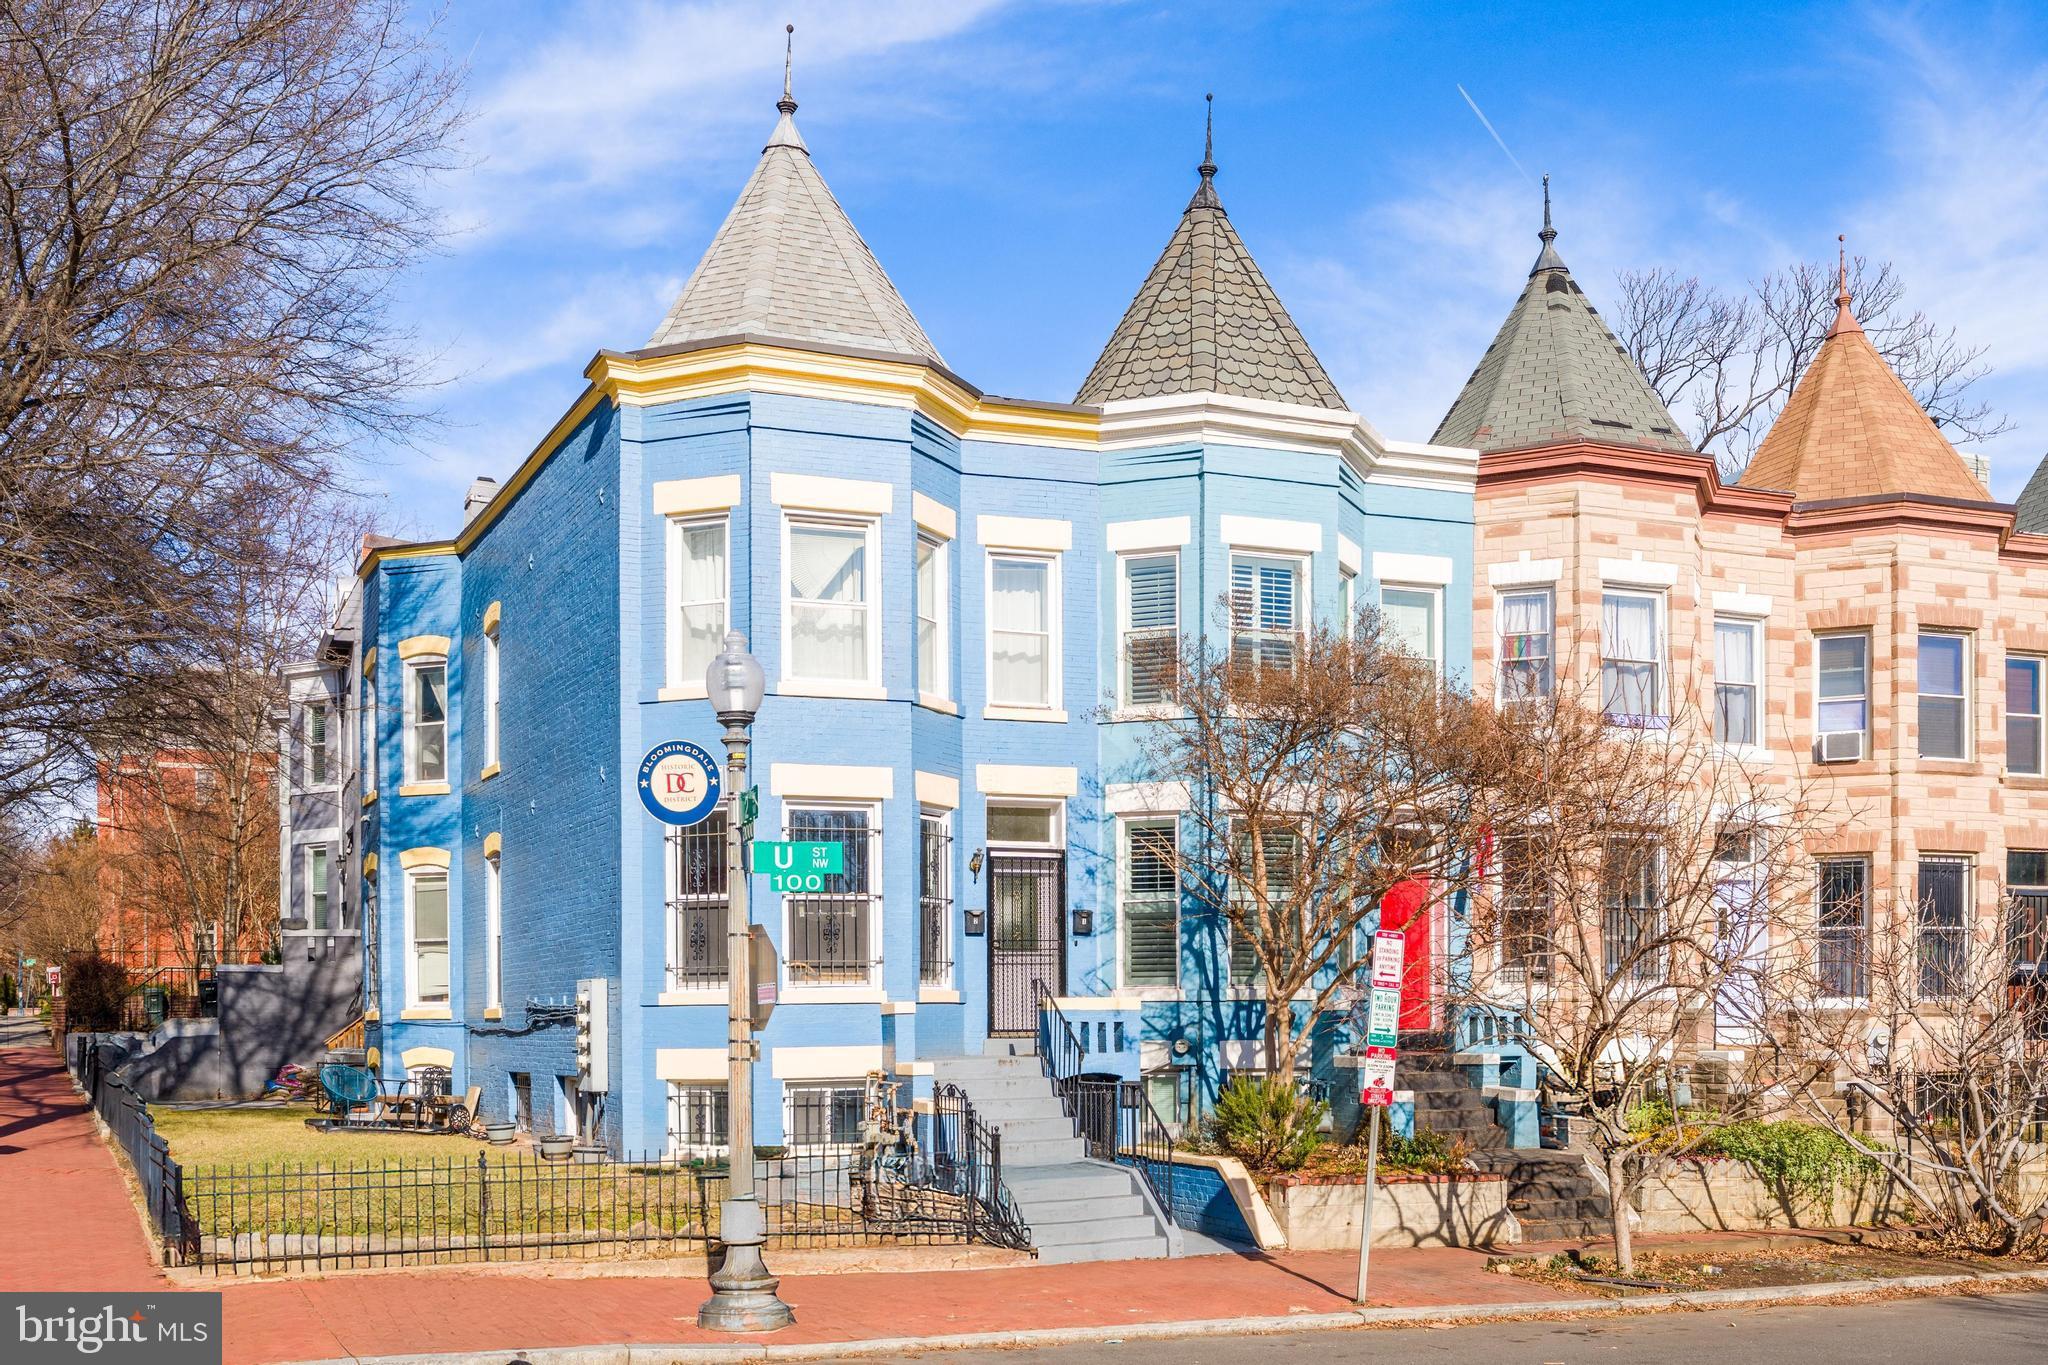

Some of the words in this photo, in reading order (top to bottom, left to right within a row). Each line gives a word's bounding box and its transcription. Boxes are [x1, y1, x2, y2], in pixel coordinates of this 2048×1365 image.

[642, 744, 714, 773] BLOOMINGDALE
[661, 763, 695, 771] HISTORIC
[664, 772, 695, 794] DC
[774, 845, 793, 869] U
[812, 846, 828, 858] ST
[812, 858, 829, 869] NW
[773, 874, 821, 890] 100
[1378, 947, 1400, 955] STANDING
[1384, 995, 1397, 1003] HOUR
[1375, 1003, 1395, 1012] PARKING
[1370, 1052, 1393, 1060] PARKING
